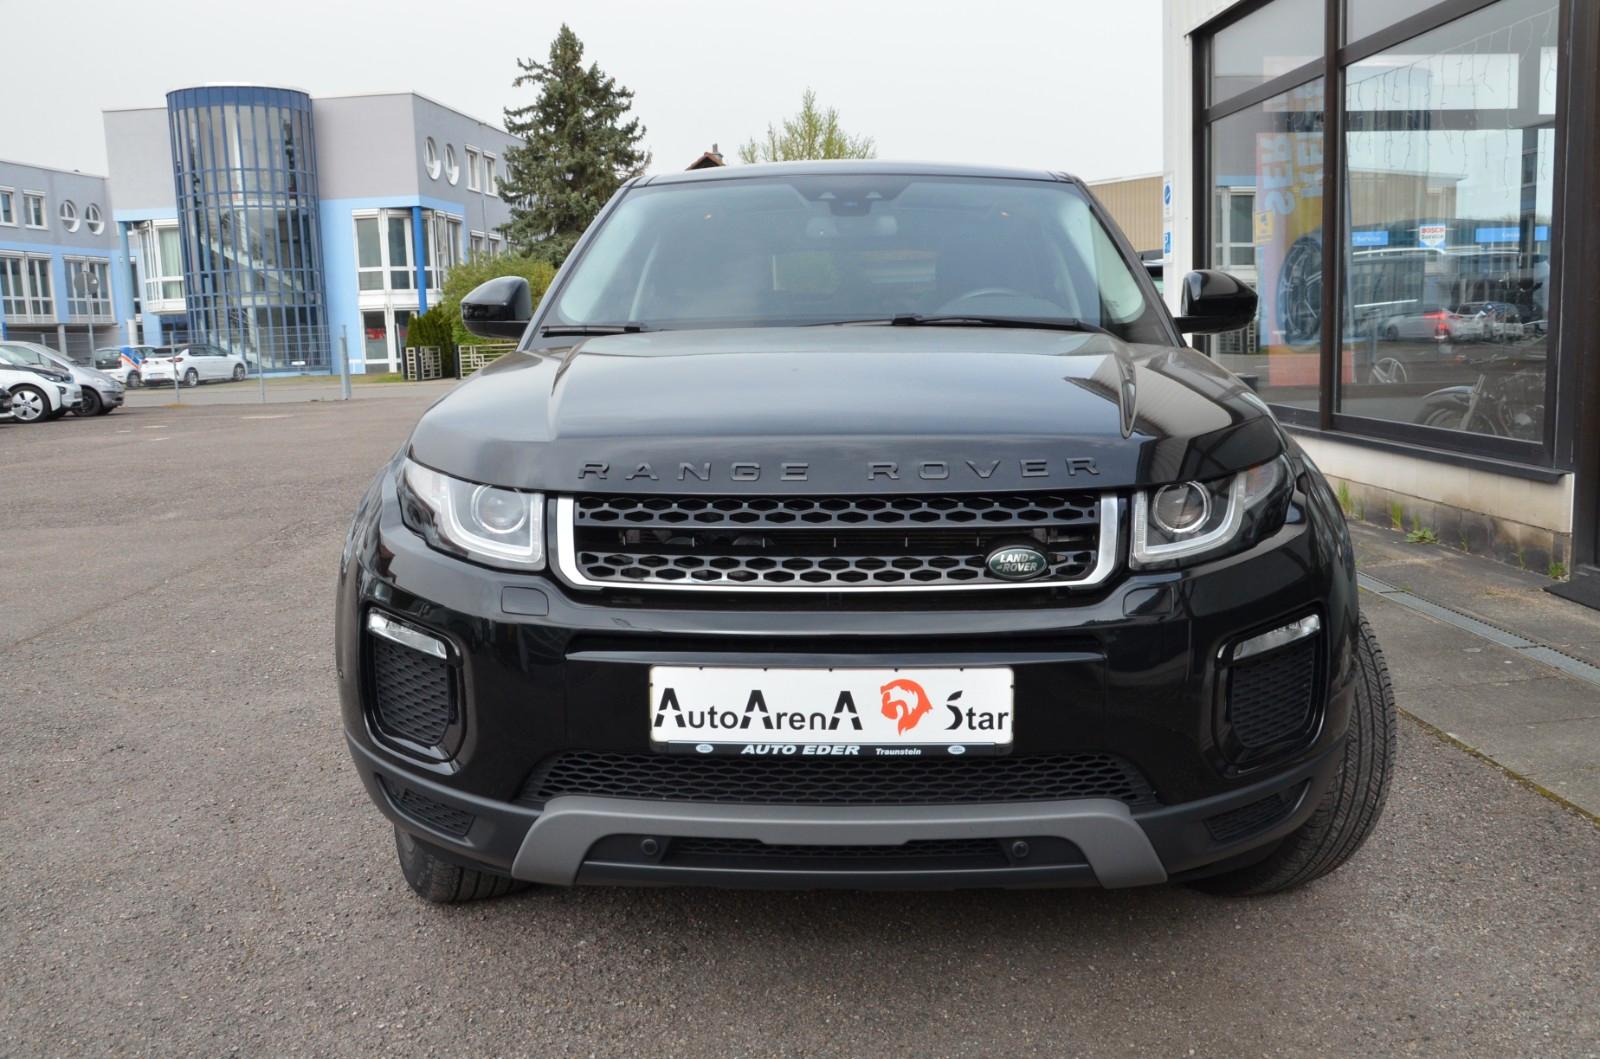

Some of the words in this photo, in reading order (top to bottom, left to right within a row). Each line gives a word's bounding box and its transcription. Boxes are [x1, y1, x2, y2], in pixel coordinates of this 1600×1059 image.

[577, 462, 809, 482] RANGE
[868, 457, 1101, 481] ROVER
[1000, 553, 1029, 564] LAND
[1002, 562, 1038, 572] ROVER
[944, 690, 1010, 731] Star
[740, 744, 797, 755] AUTO
[802, 745, 860, 756] EDER
[875, 747, 922, 756] Traunstein
